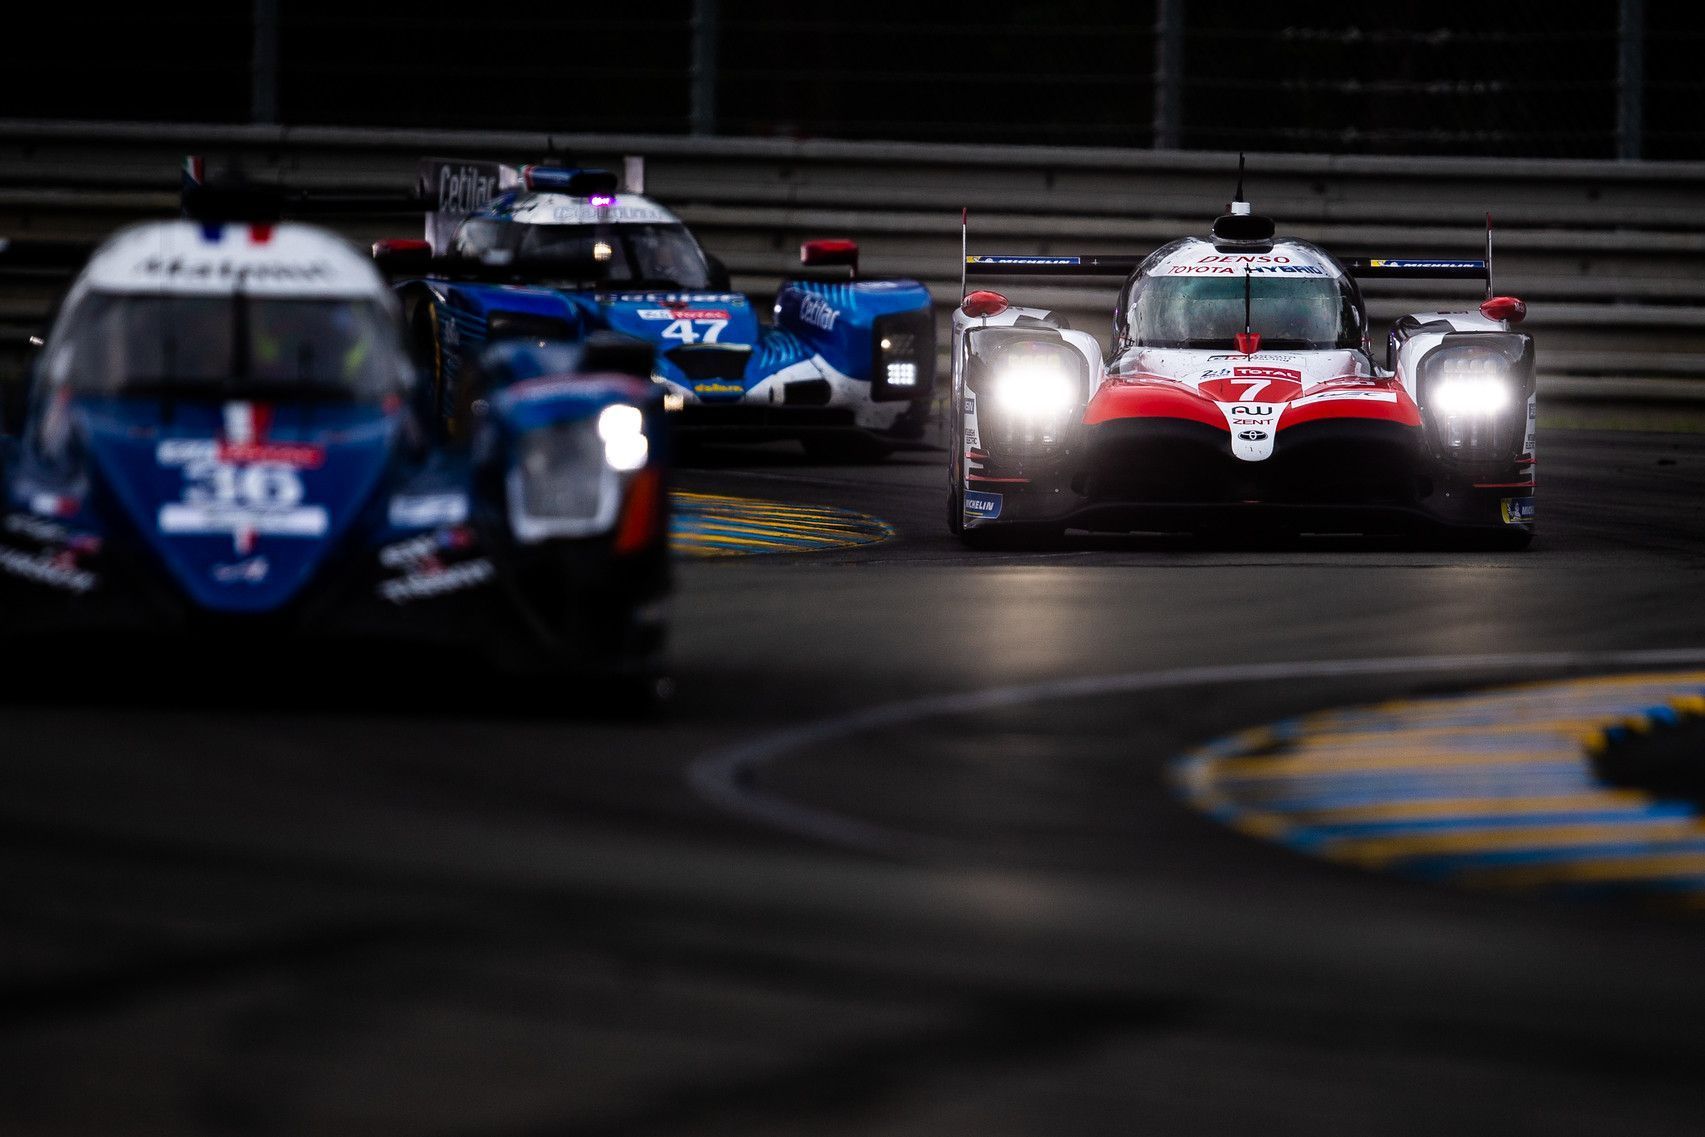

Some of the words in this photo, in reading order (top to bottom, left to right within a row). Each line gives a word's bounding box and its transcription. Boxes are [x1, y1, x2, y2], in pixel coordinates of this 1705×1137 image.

[1198, 255, 1291, 264] DENSO
[1168, 265, 1235, 274] TOYOTA
[660, 319, 729, 344] 47
[1236, 368, 1300, 380] TOTAL
[1230, 379, 1272, 402] 7
[181, 463, 305, 508] 36
